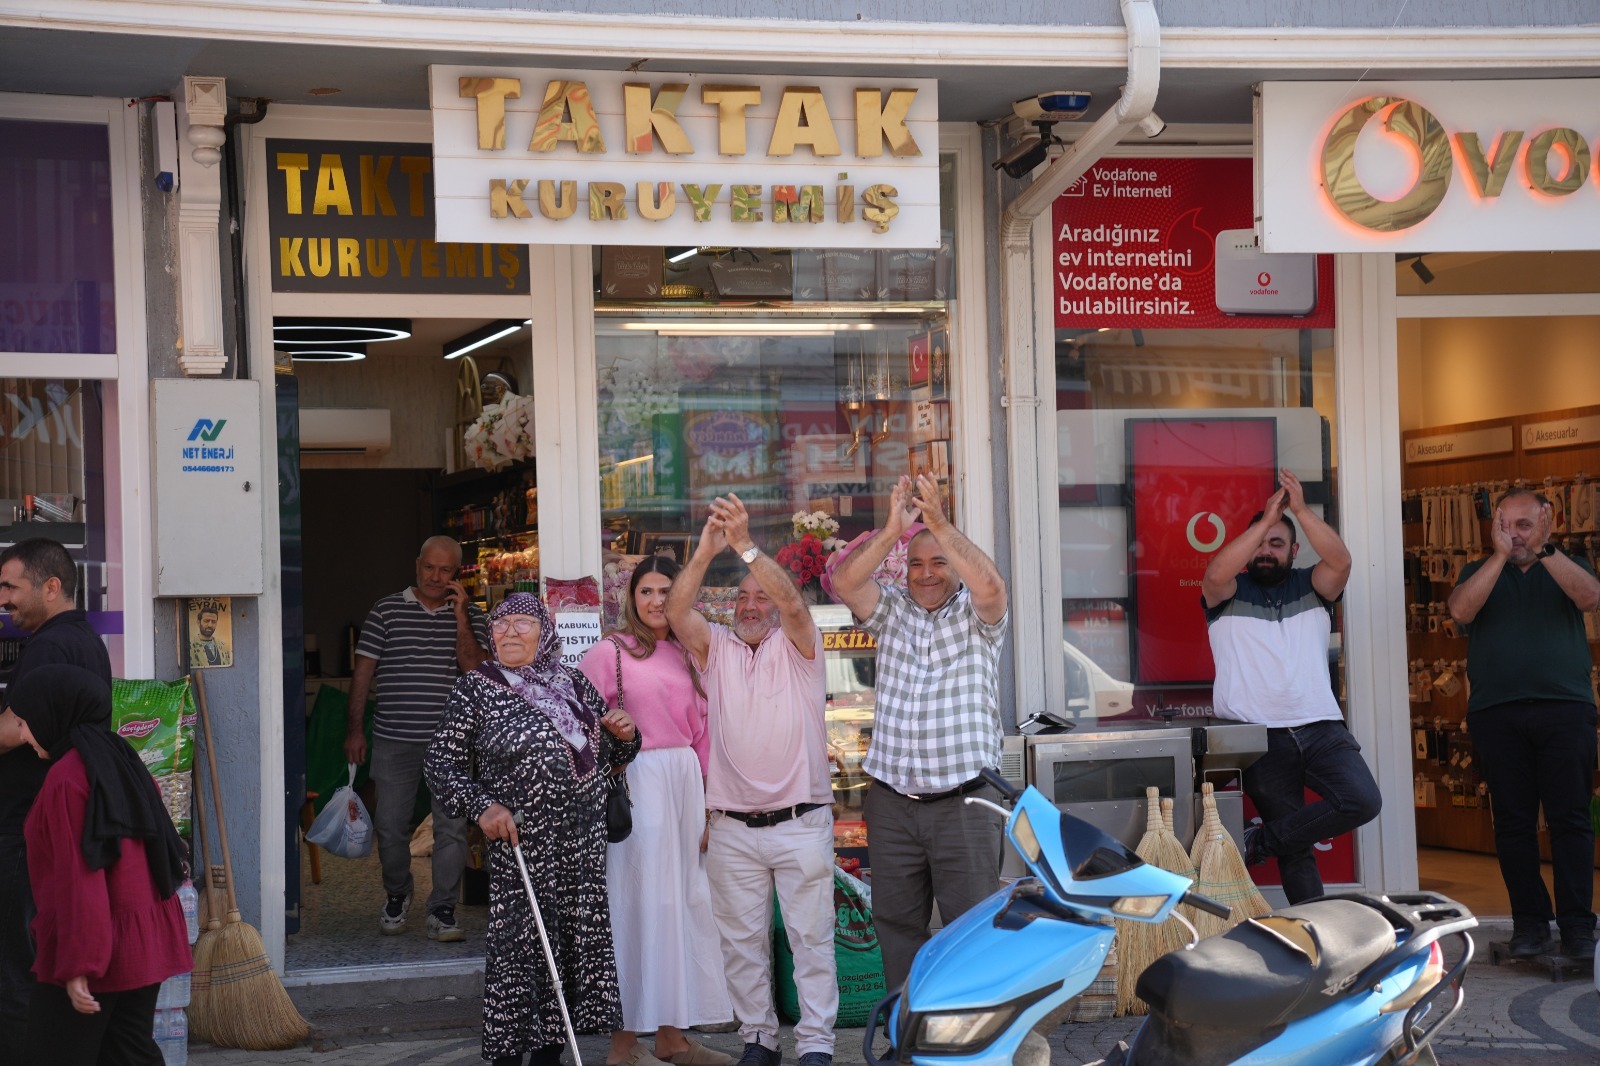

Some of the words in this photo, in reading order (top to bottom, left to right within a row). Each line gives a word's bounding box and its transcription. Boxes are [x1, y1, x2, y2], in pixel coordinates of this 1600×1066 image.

[458, 76, 923, 158] TAKTAK
[1092, 167, 1158, 182] Vodafone
[1093, 184, 1110, 198] Ev
[1113, 181, 1172, 198] İnterneti
[489, 172, 900, 234] KURUYEMİŞ
[1058, 223, 1160, 247] Aradığınız
[1059, 251, 1083, 267] ev
[1087, 248, 1192, 267] internetini
[1060, 296, 1195, 315] bulabilirsiniz.
[1534, 426, 1579, 441] Aksesuarlar
[182, 447, 200, 459] NET
[1416, 442, 1454, 456] Aksesuarlar
[558, 635, 599, 645] FISTIK
[854, 983, 872, 993] 342
